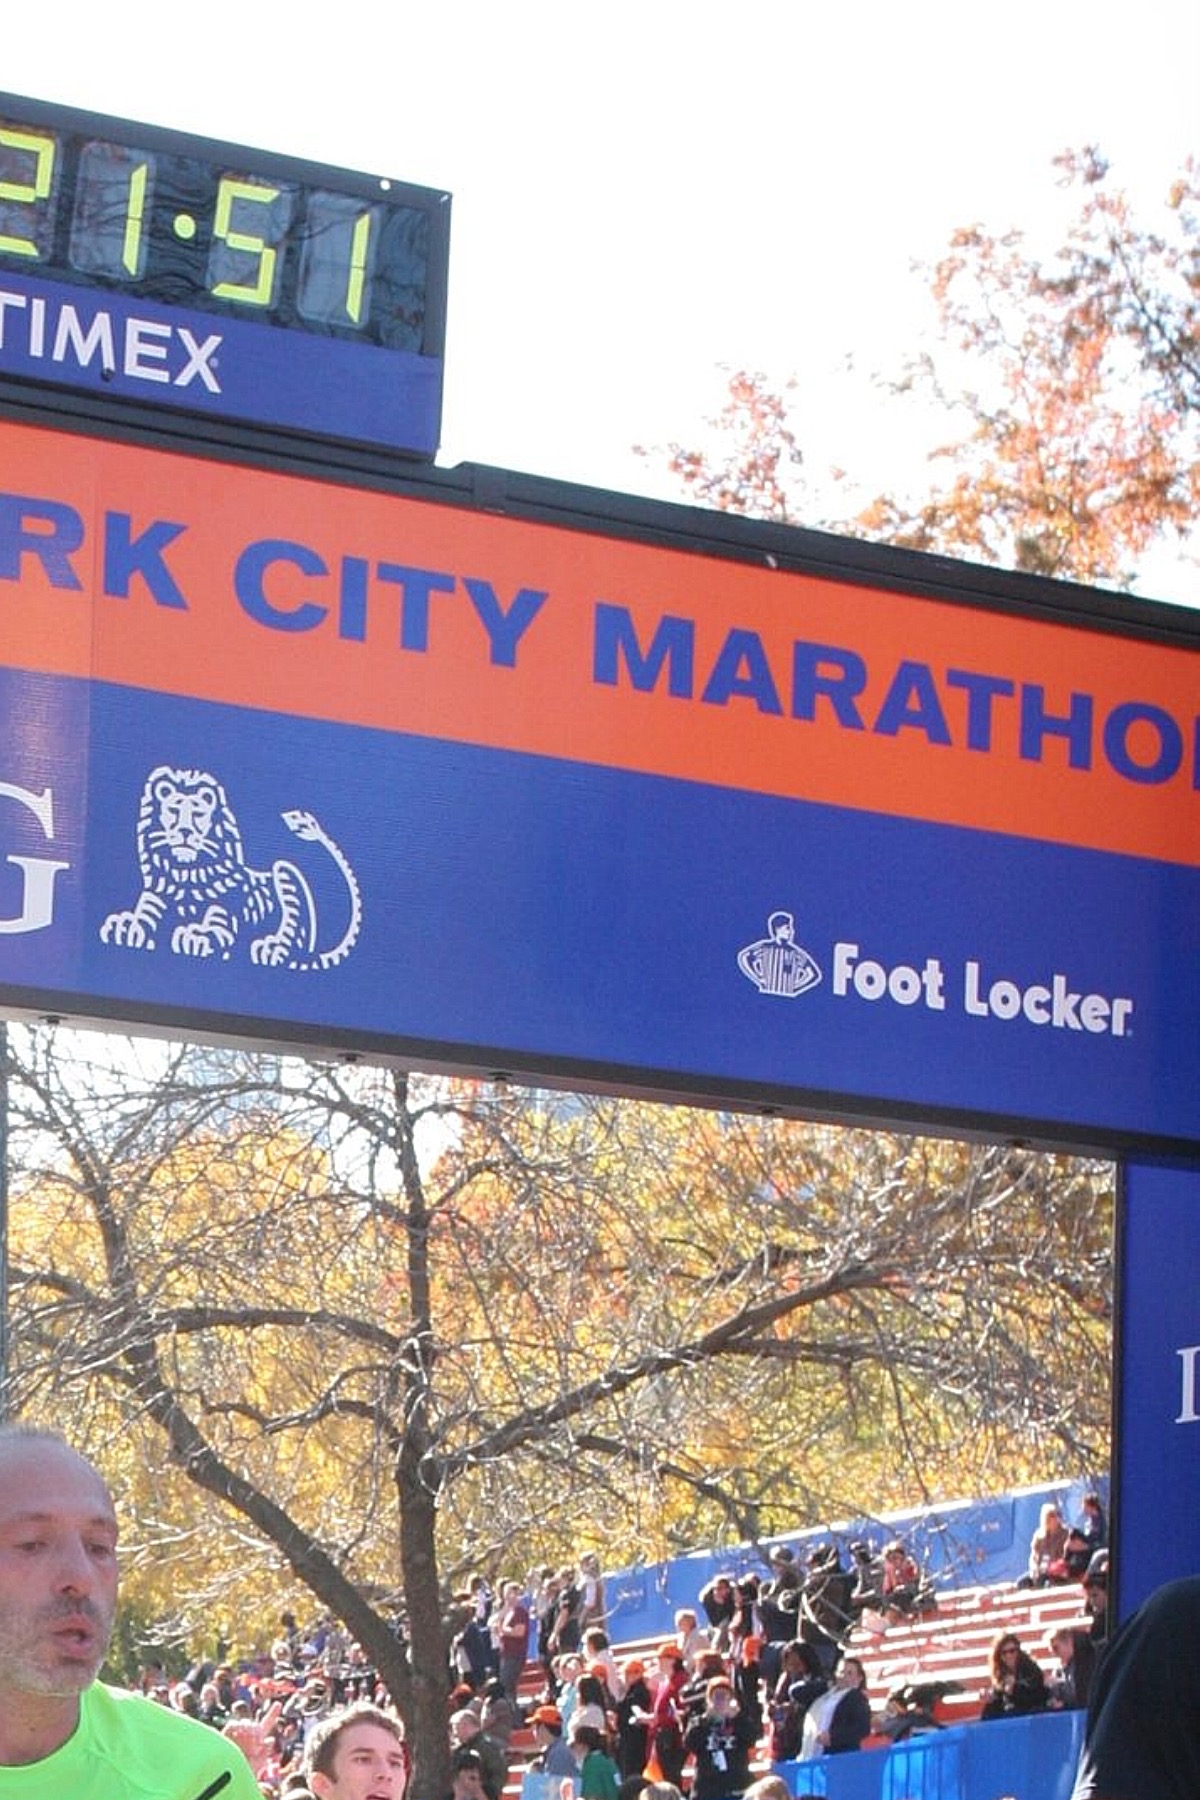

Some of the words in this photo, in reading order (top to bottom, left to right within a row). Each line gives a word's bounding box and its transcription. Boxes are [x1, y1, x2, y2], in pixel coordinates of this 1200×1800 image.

[233, 539, 549, 668] CITY
[593, 602, 1200, 791] MARATHO
[833, 942, 945, 1010] Foot
[965, 961, 1131, 1036] Locker
